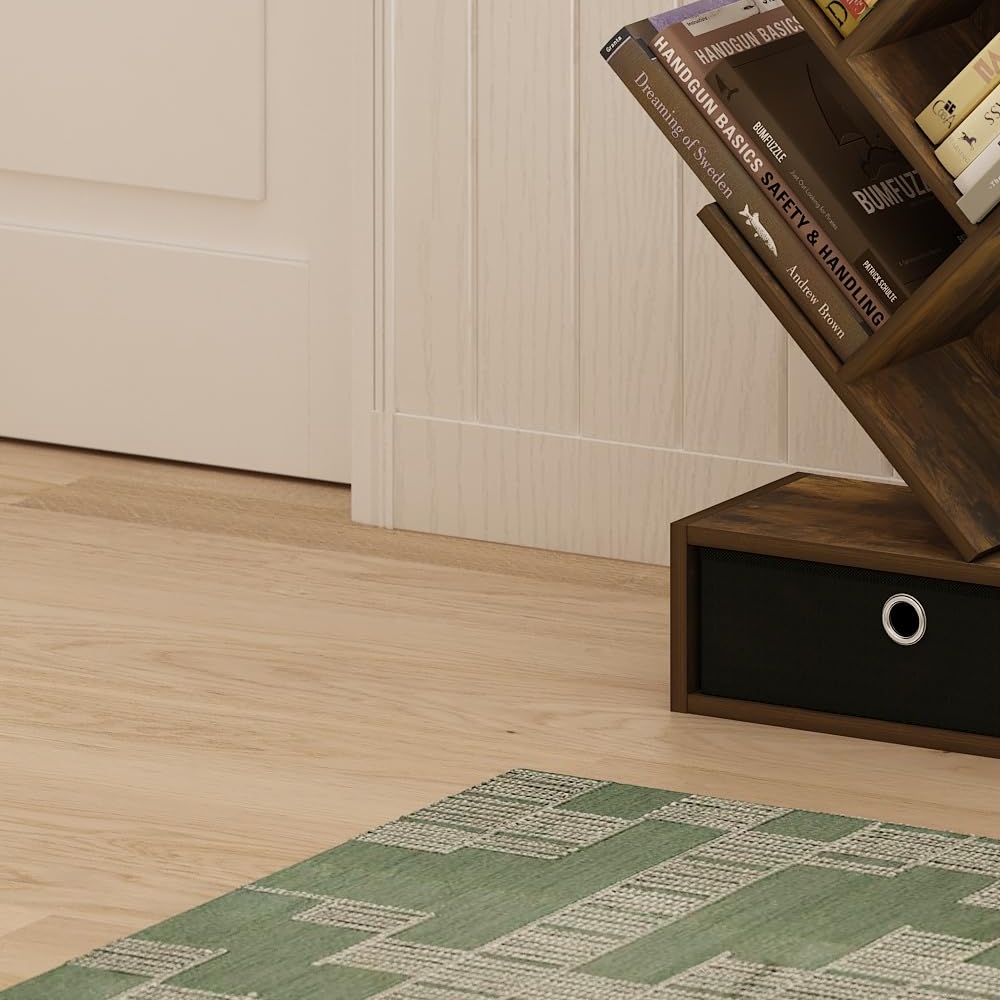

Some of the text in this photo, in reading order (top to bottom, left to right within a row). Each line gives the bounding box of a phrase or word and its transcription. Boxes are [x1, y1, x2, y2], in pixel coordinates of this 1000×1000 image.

[605, 36, 623, 53] Granta
[694, 31, 761, 65] HANDGUN
[752, 121, 788, 164] BUMFUZZLE
[653, 35, 719, 116] HANDGUN
[714, 113, 763, 173] BASICS
[760, 171, 810, 229] SAFETY
[806, 229, 820, 247] &
[818, 244, 885, 327] HANDLING
[634, 71, 846, 340] Dreaming of Sweden Andrew Brown
[862, 259, 898, 303] PATRICK SCHULTE
